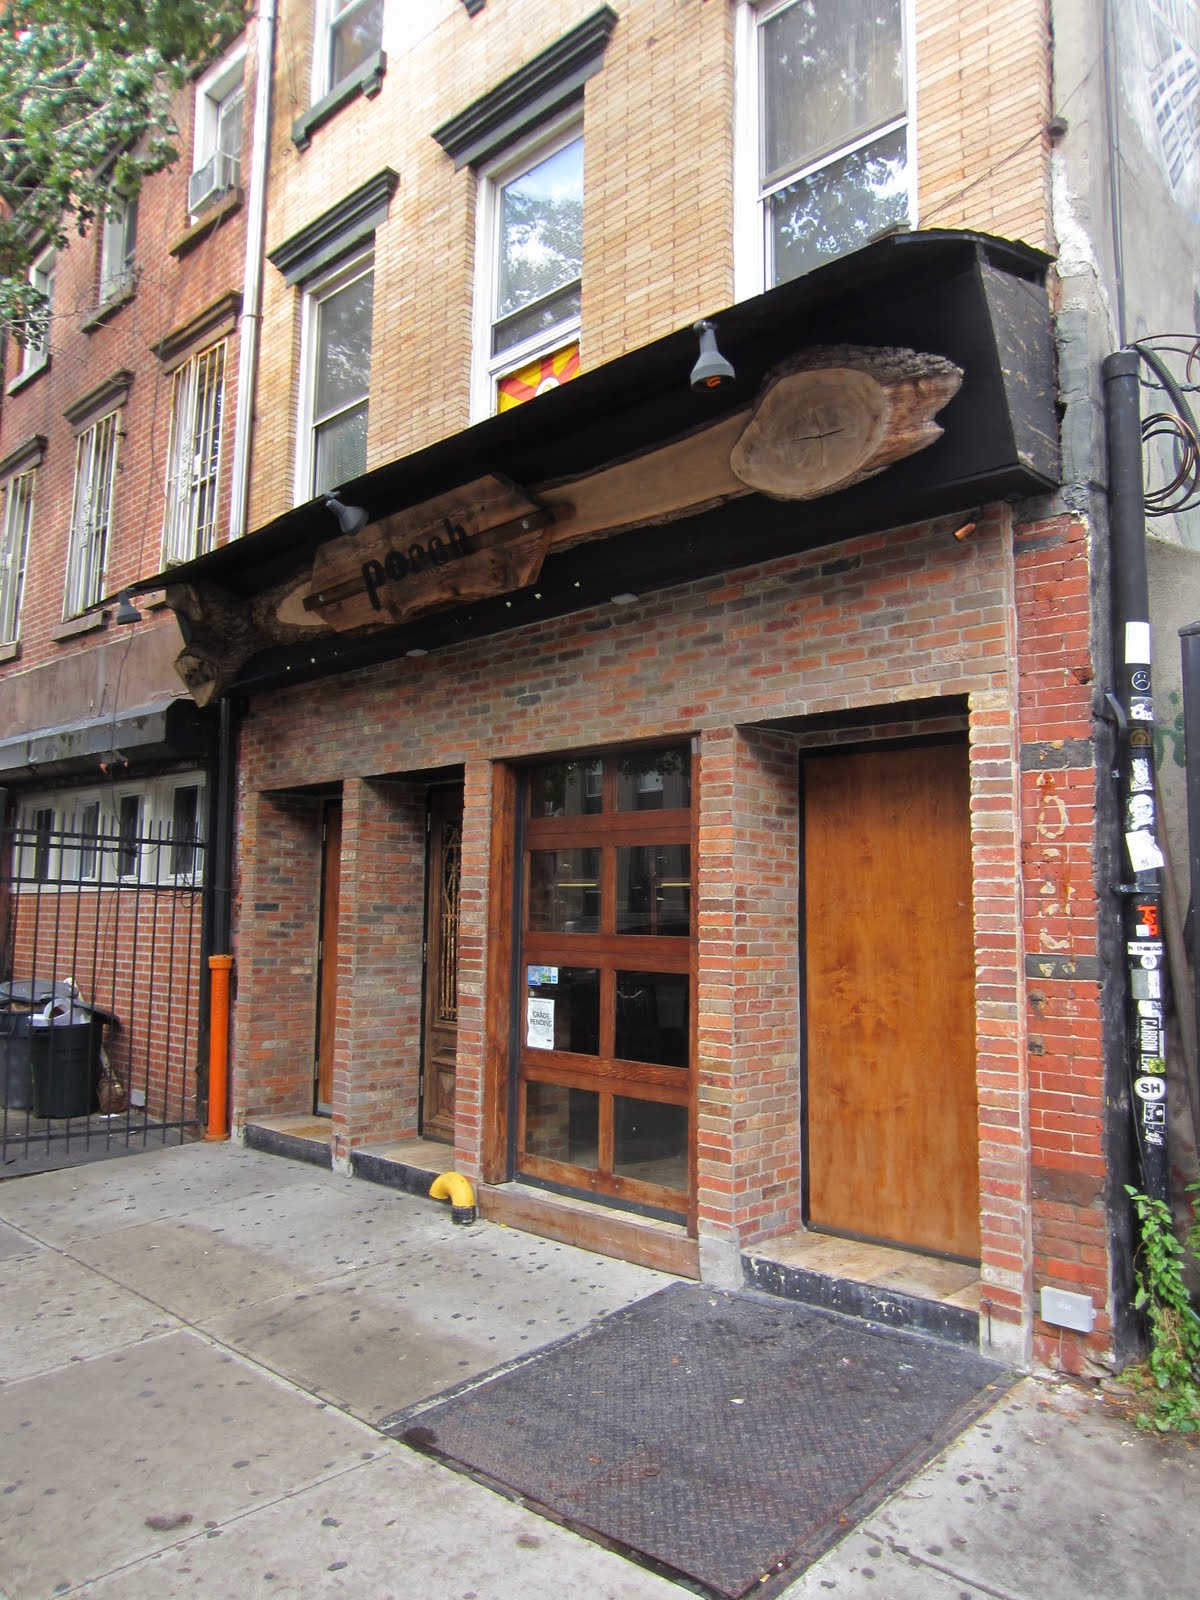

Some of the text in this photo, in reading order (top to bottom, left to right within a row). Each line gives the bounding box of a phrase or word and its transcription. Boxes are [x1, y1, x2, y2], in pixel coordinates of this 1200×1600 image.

[532, 1011, 550, 1020] GRADE
[530, 1018, 552, 1027] PENDING
[1141, 1019, 1158, 1051] CARBON
[1141, 1083, 1161, 1093] SH
